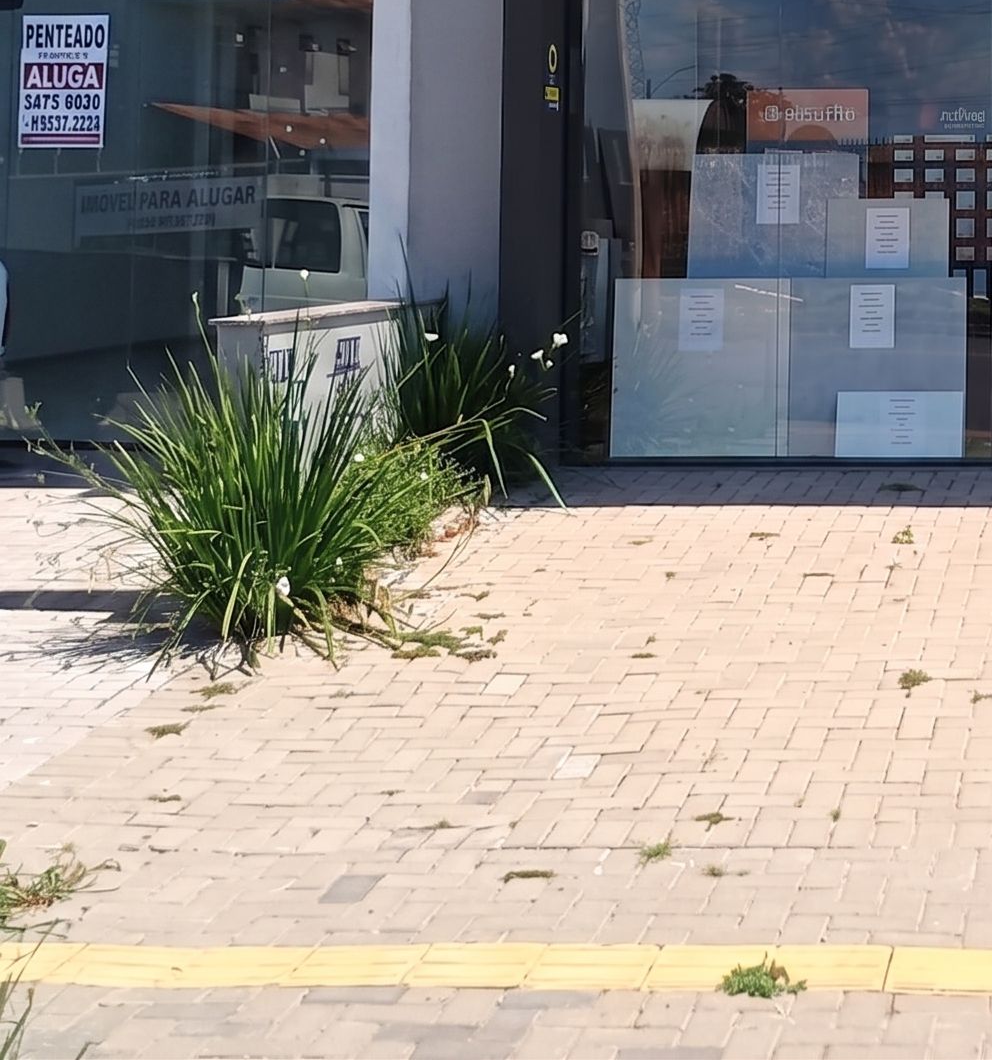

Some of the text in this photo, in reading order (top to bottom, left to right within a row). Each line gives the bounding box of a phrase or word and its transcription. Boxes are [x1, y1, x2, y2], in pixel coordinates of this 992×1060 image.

[26, 24, 105, 49] PENTEADO
[26, 65, 100, 88] ALUGA
[65, 93, 100, 110] 6030
[140, 189, 182, 209] PARA
[187, 185, 256, 207] ALUGAR
